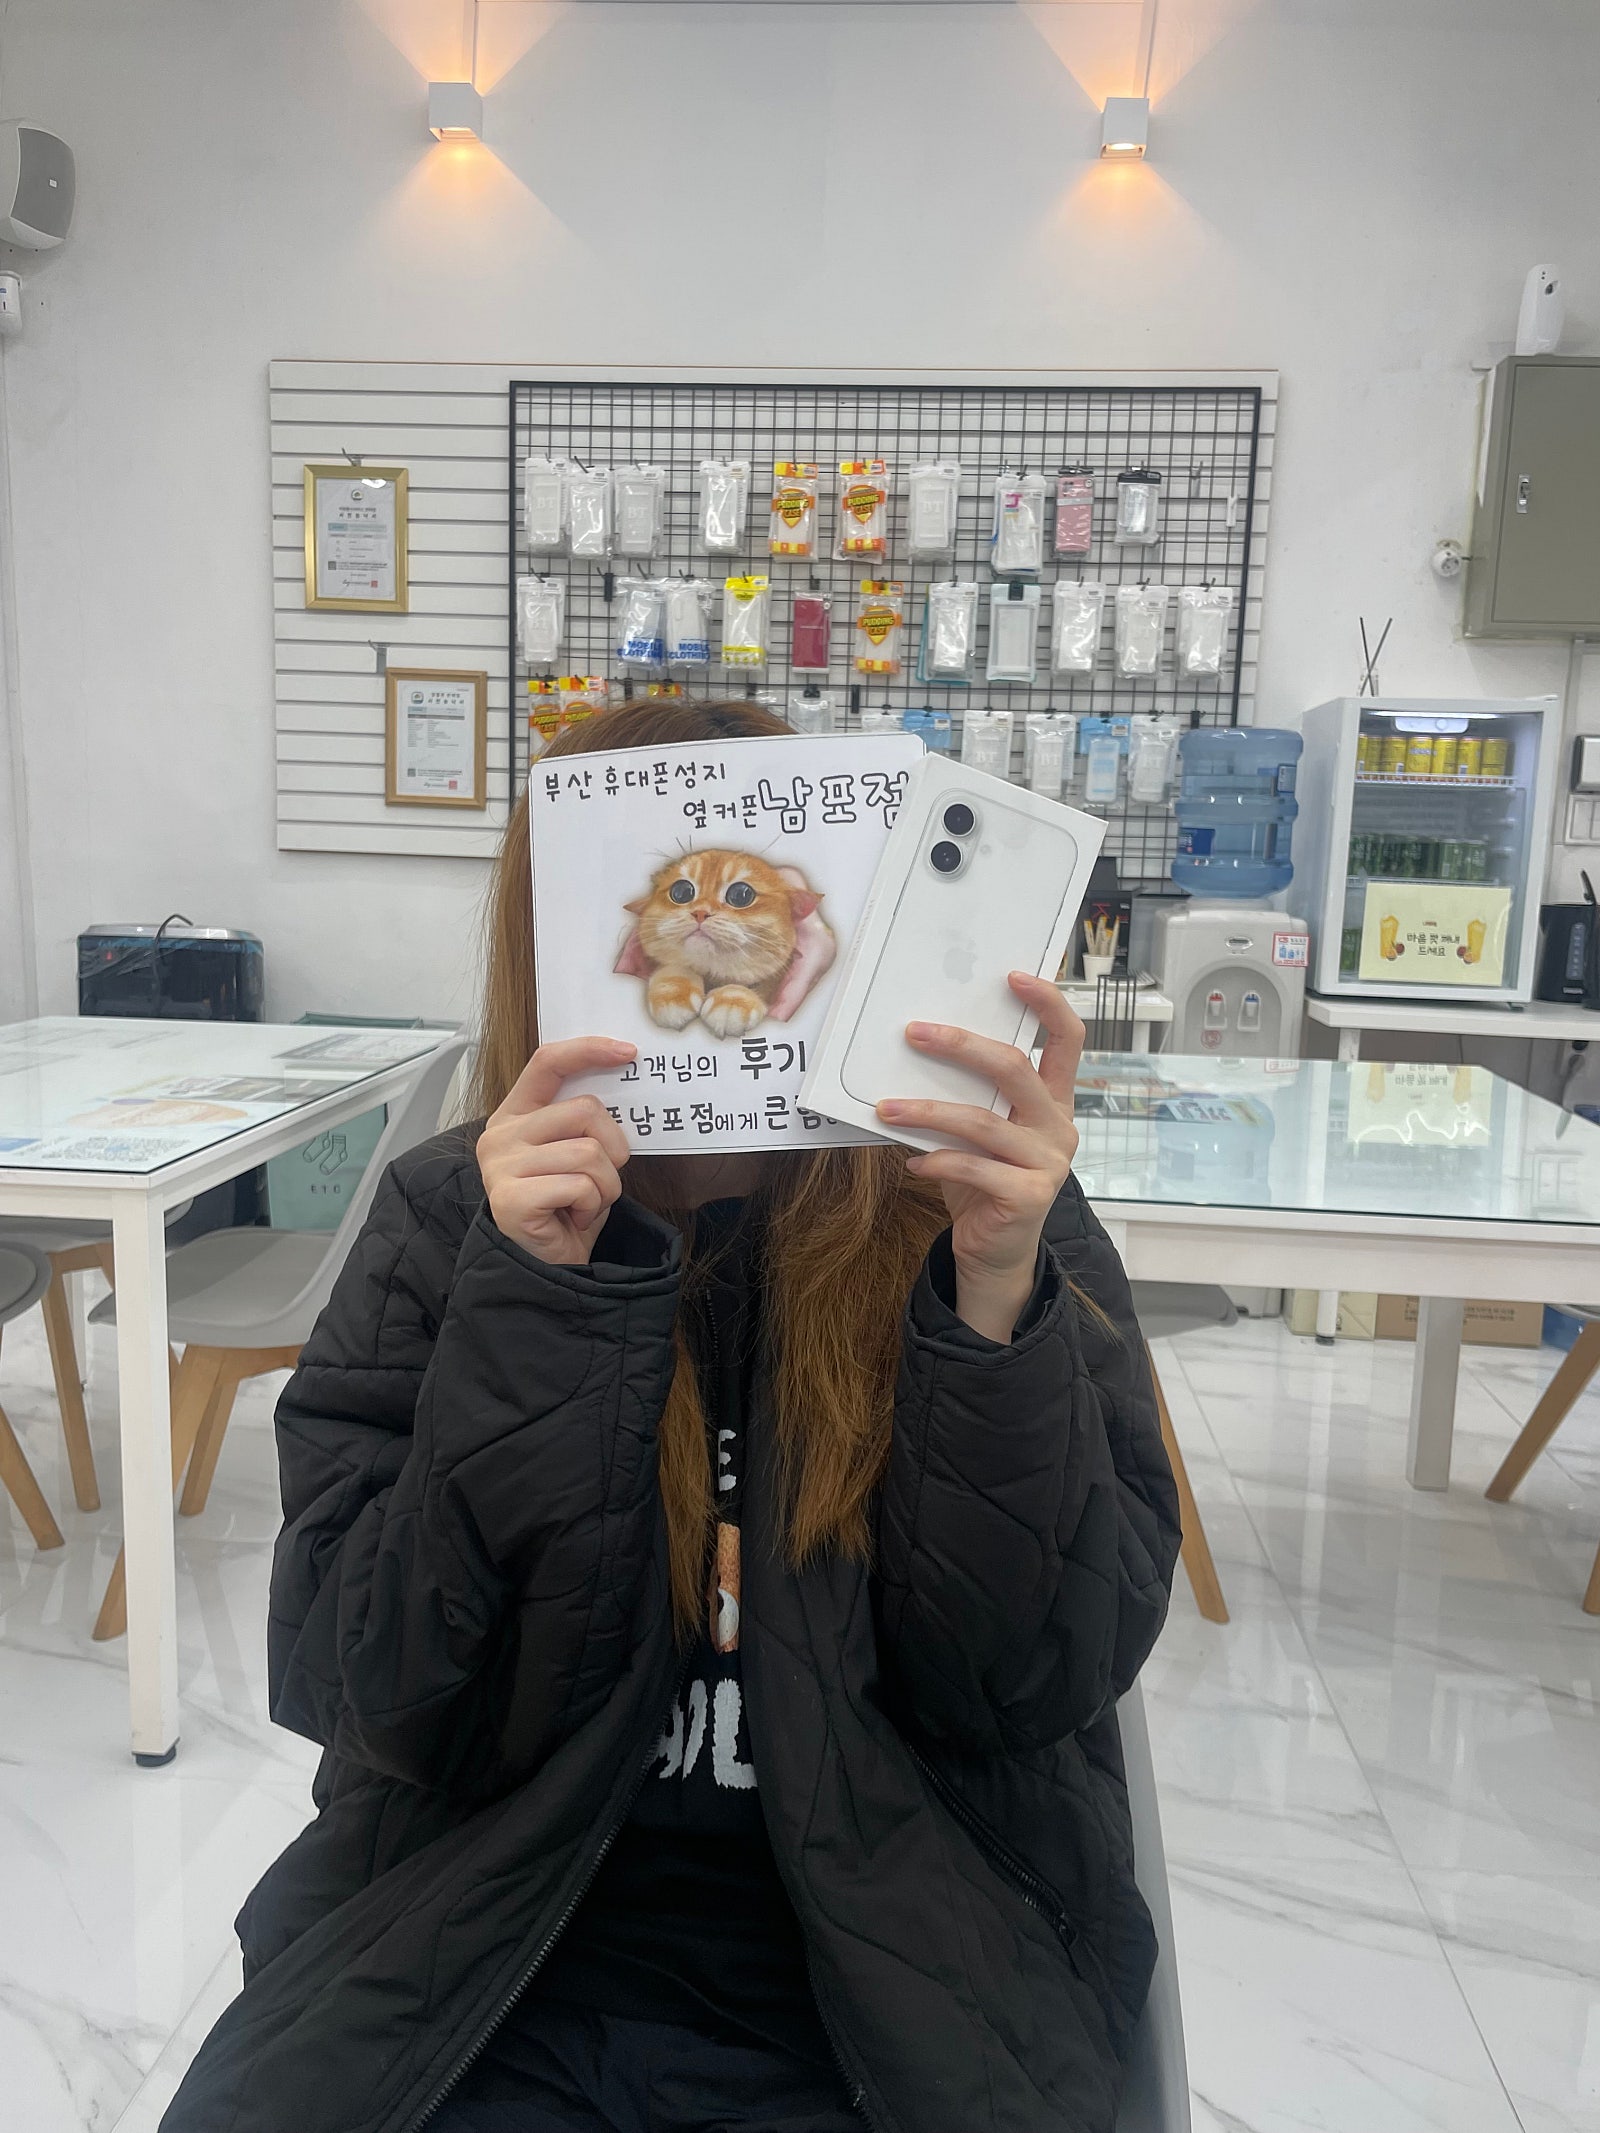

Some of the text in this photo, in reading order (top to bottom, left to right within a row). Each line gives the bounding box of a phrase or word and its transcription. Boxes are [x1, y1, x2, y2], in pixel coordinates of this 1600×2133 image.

[545, 761, 726, 802] 부산 휴대폰성지
[620, 1037, 806, 1084] 고객님의 후기
